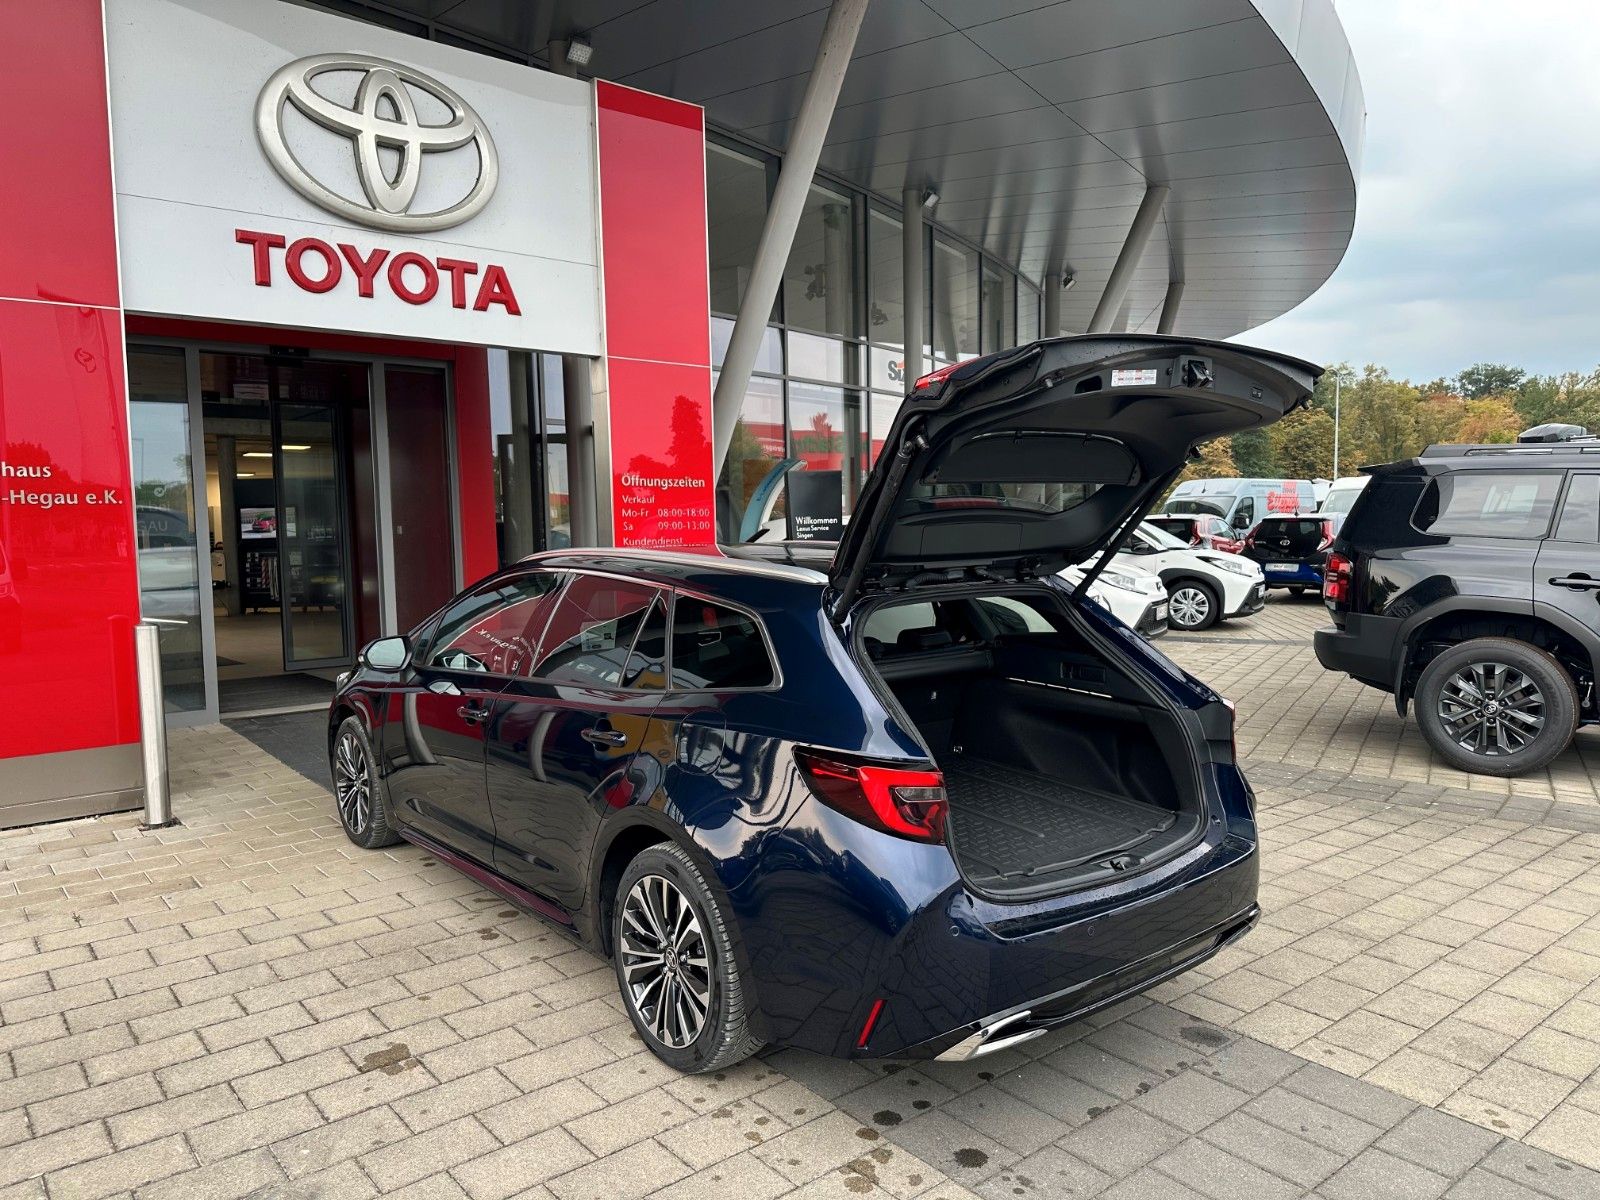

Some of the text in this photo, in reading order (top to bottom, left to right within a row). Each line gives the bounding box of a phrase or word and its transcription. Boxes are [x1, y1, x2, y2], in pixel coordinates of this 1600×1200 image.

[235, 228, 522, 316] TOYOTA
[887, 360, 904, 382] Si
[1, 461, 52, 478] haus
[621, 473, 705, 490] Öffnungszeiten
[85, 489, 123, 505] e.K.
[622, 495, 655, 504] Verkauf
[621, 508, 710, 518] Mo-Fr 08:00-18:00
[623, 521, 710, 531] Sa 09:00-13:00
[795, 516, 838, 525] Willkommen
[623, 537, 683, 547] Kundendienst
